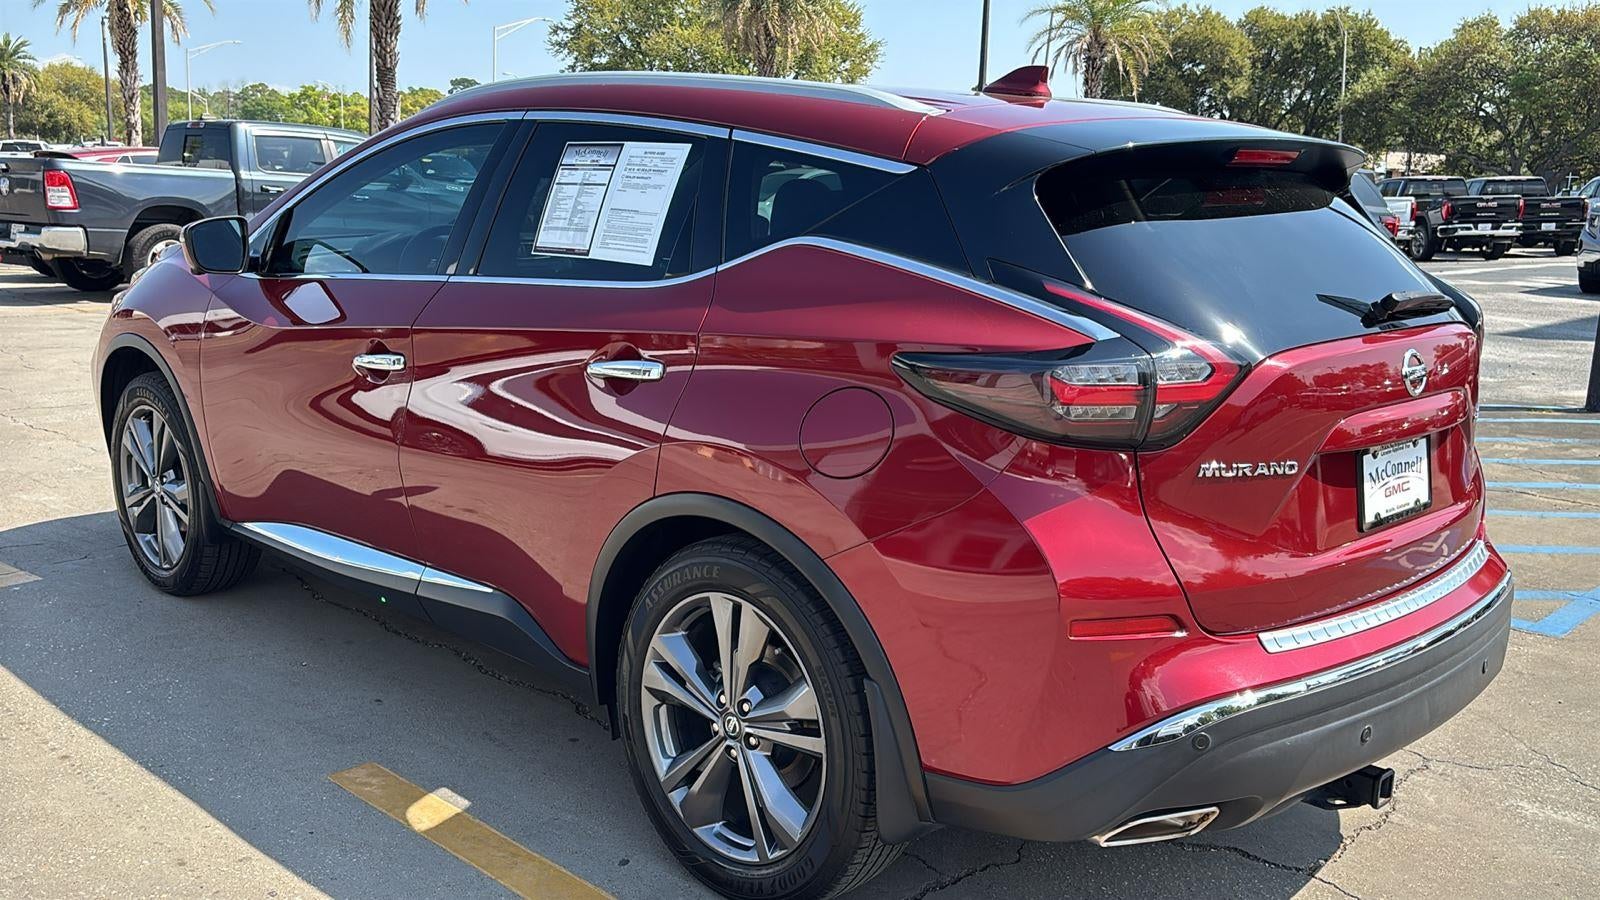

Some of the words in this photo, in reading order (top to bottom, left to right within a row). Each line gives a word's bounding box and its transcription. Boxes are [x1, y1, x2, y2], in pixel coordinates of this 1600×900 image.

[1197, 459, 1299, 478] MURANO
[1368, 456, 1422, 489] McConnell
[1384, 480, 1411, 498] GMC
[645, 565, 721, 612] ASSURANCE
